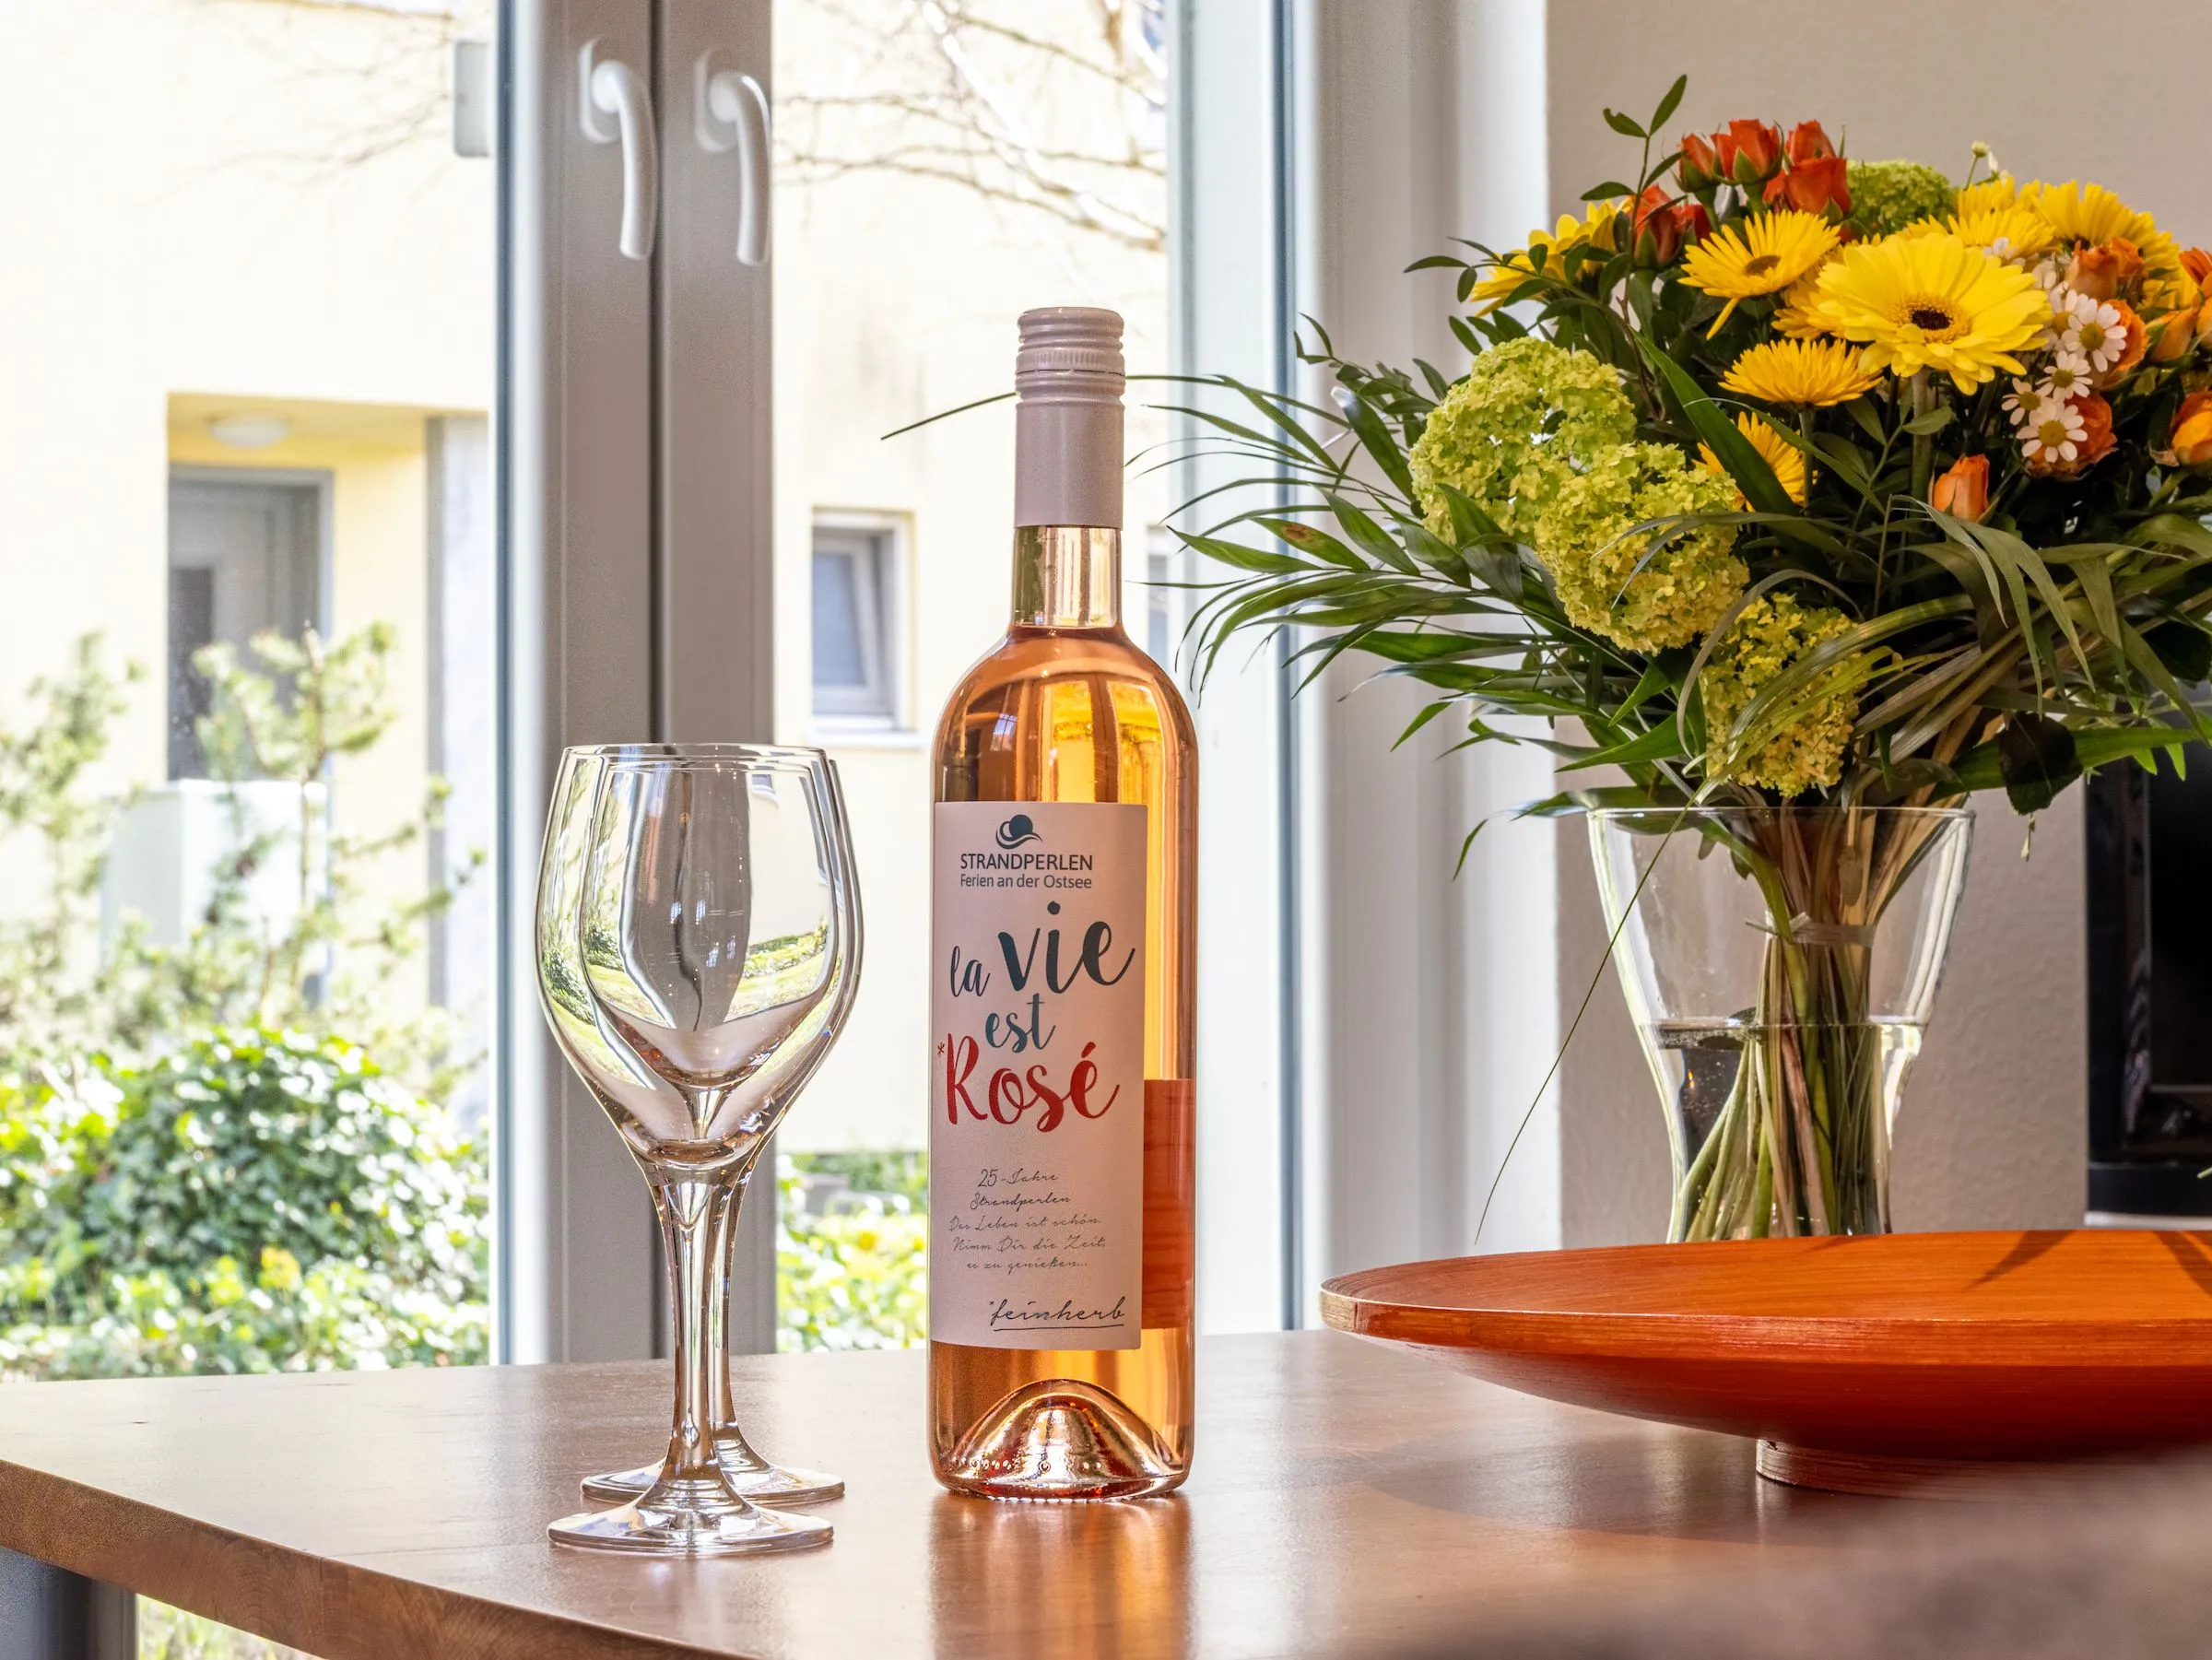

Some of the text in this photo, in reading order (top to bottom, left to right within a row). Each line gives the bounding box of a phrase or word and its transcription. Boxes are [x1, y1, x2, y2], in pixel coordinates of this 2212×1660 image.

[960, 854, 1093, 871] STRANDPERLEN
[960, 874, 1092, 889] Ferien an der Ostsee
[950, 901, 1135, 997] la vie
[985, 993, 1056, 1054] est
[947, 1032, 1120, 1133] Rosé
[970, 1192, 1071, 1212] Strandperlen
[975, 1215, 1018, 1231] Leben
[1032, 1238, 1057, 1250] die
